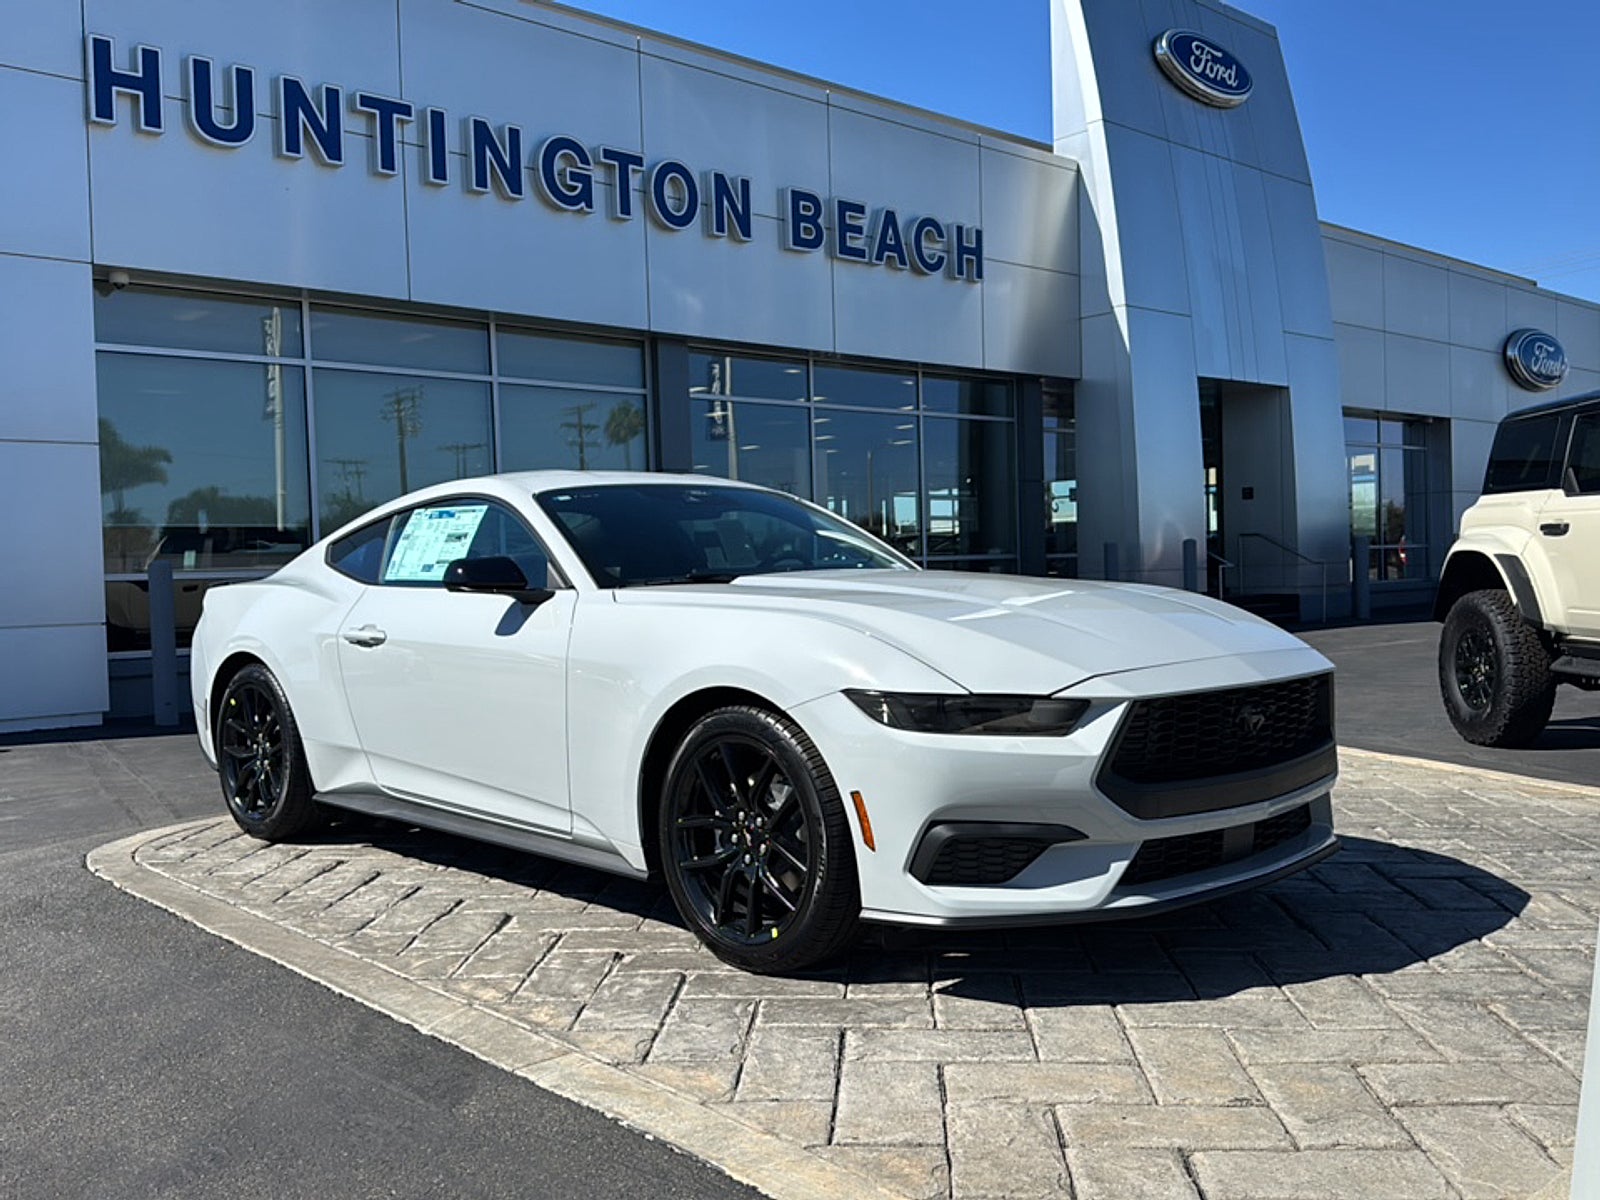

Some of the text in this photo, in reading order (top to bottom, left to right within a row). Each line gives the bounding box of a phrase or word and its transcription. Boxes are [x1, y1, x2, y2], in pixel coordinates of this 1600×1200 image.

[1190, 41, 1238, 87] Ford
[88, 34, 984, 282] HUNTINGTON BEACH
[1531, 342, 1562, 376] Ford
